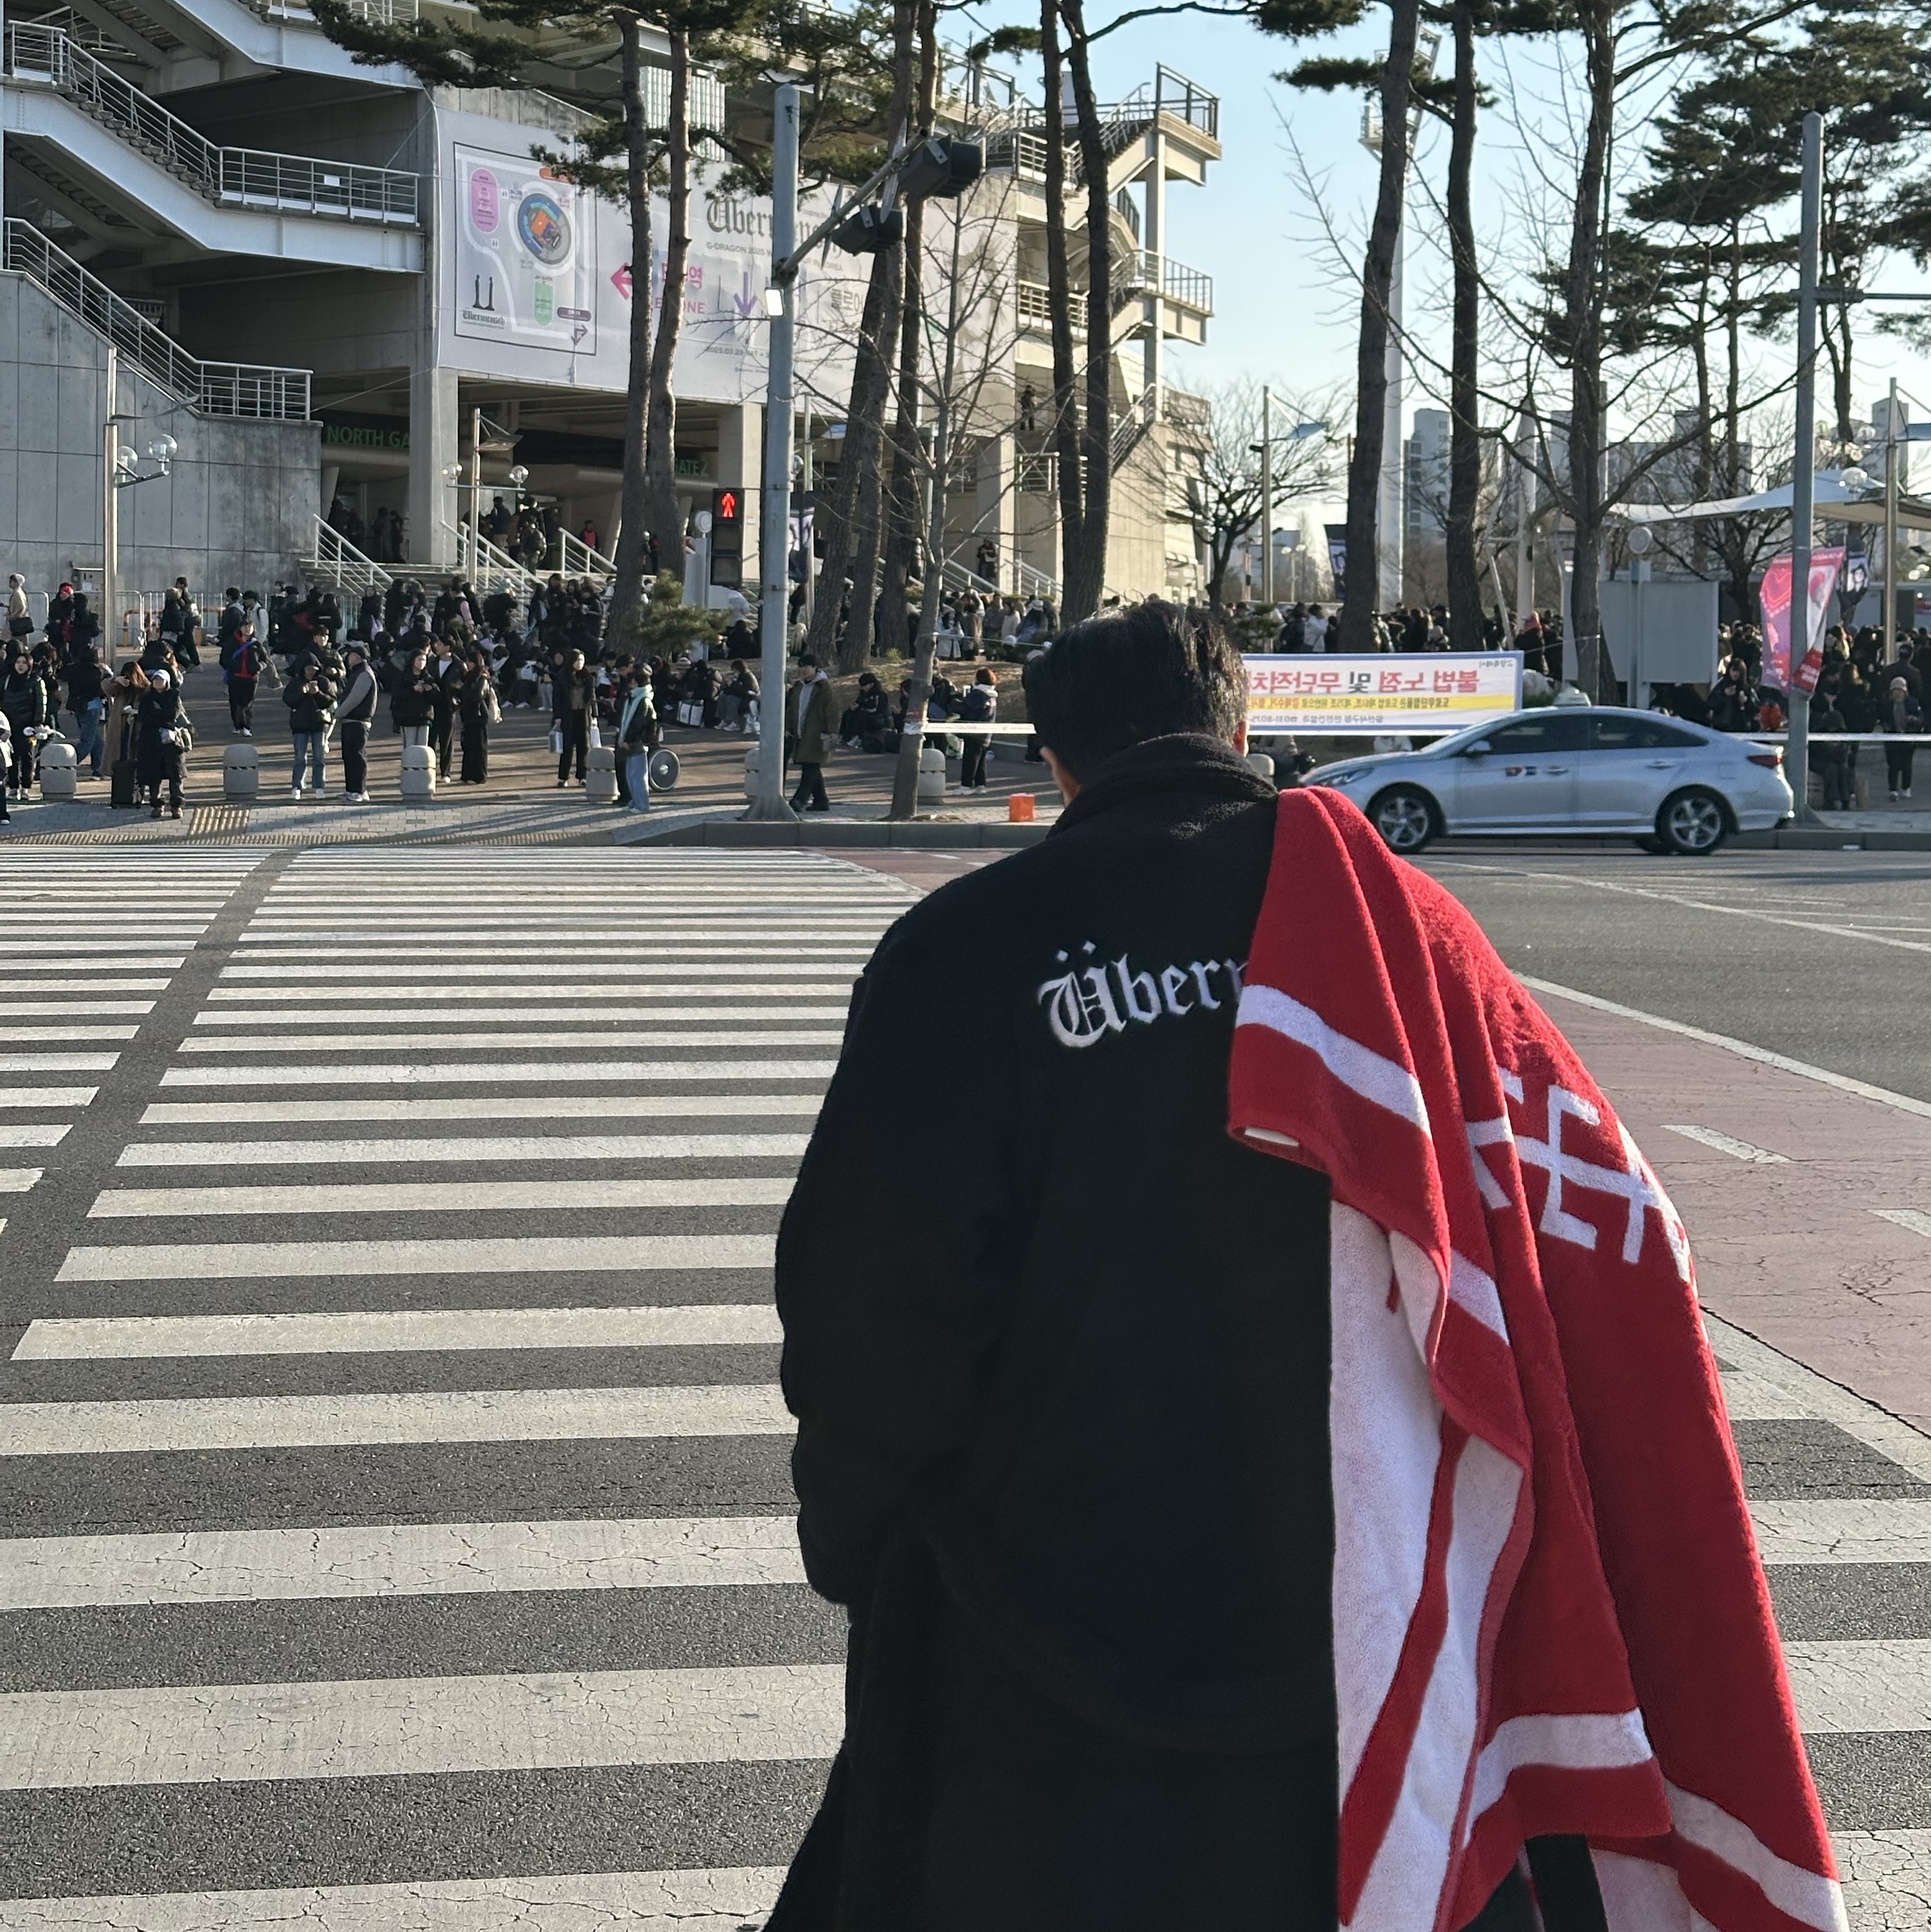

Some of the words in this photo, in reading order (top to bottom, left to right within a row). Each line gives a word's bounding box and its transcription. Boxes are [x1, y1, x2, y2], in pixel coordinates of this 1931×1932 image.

[706, 242, 747, 254] G-DRAGON
[747, 247, 765, 256] 2025
[327, 425, 383, 447] NORTH
